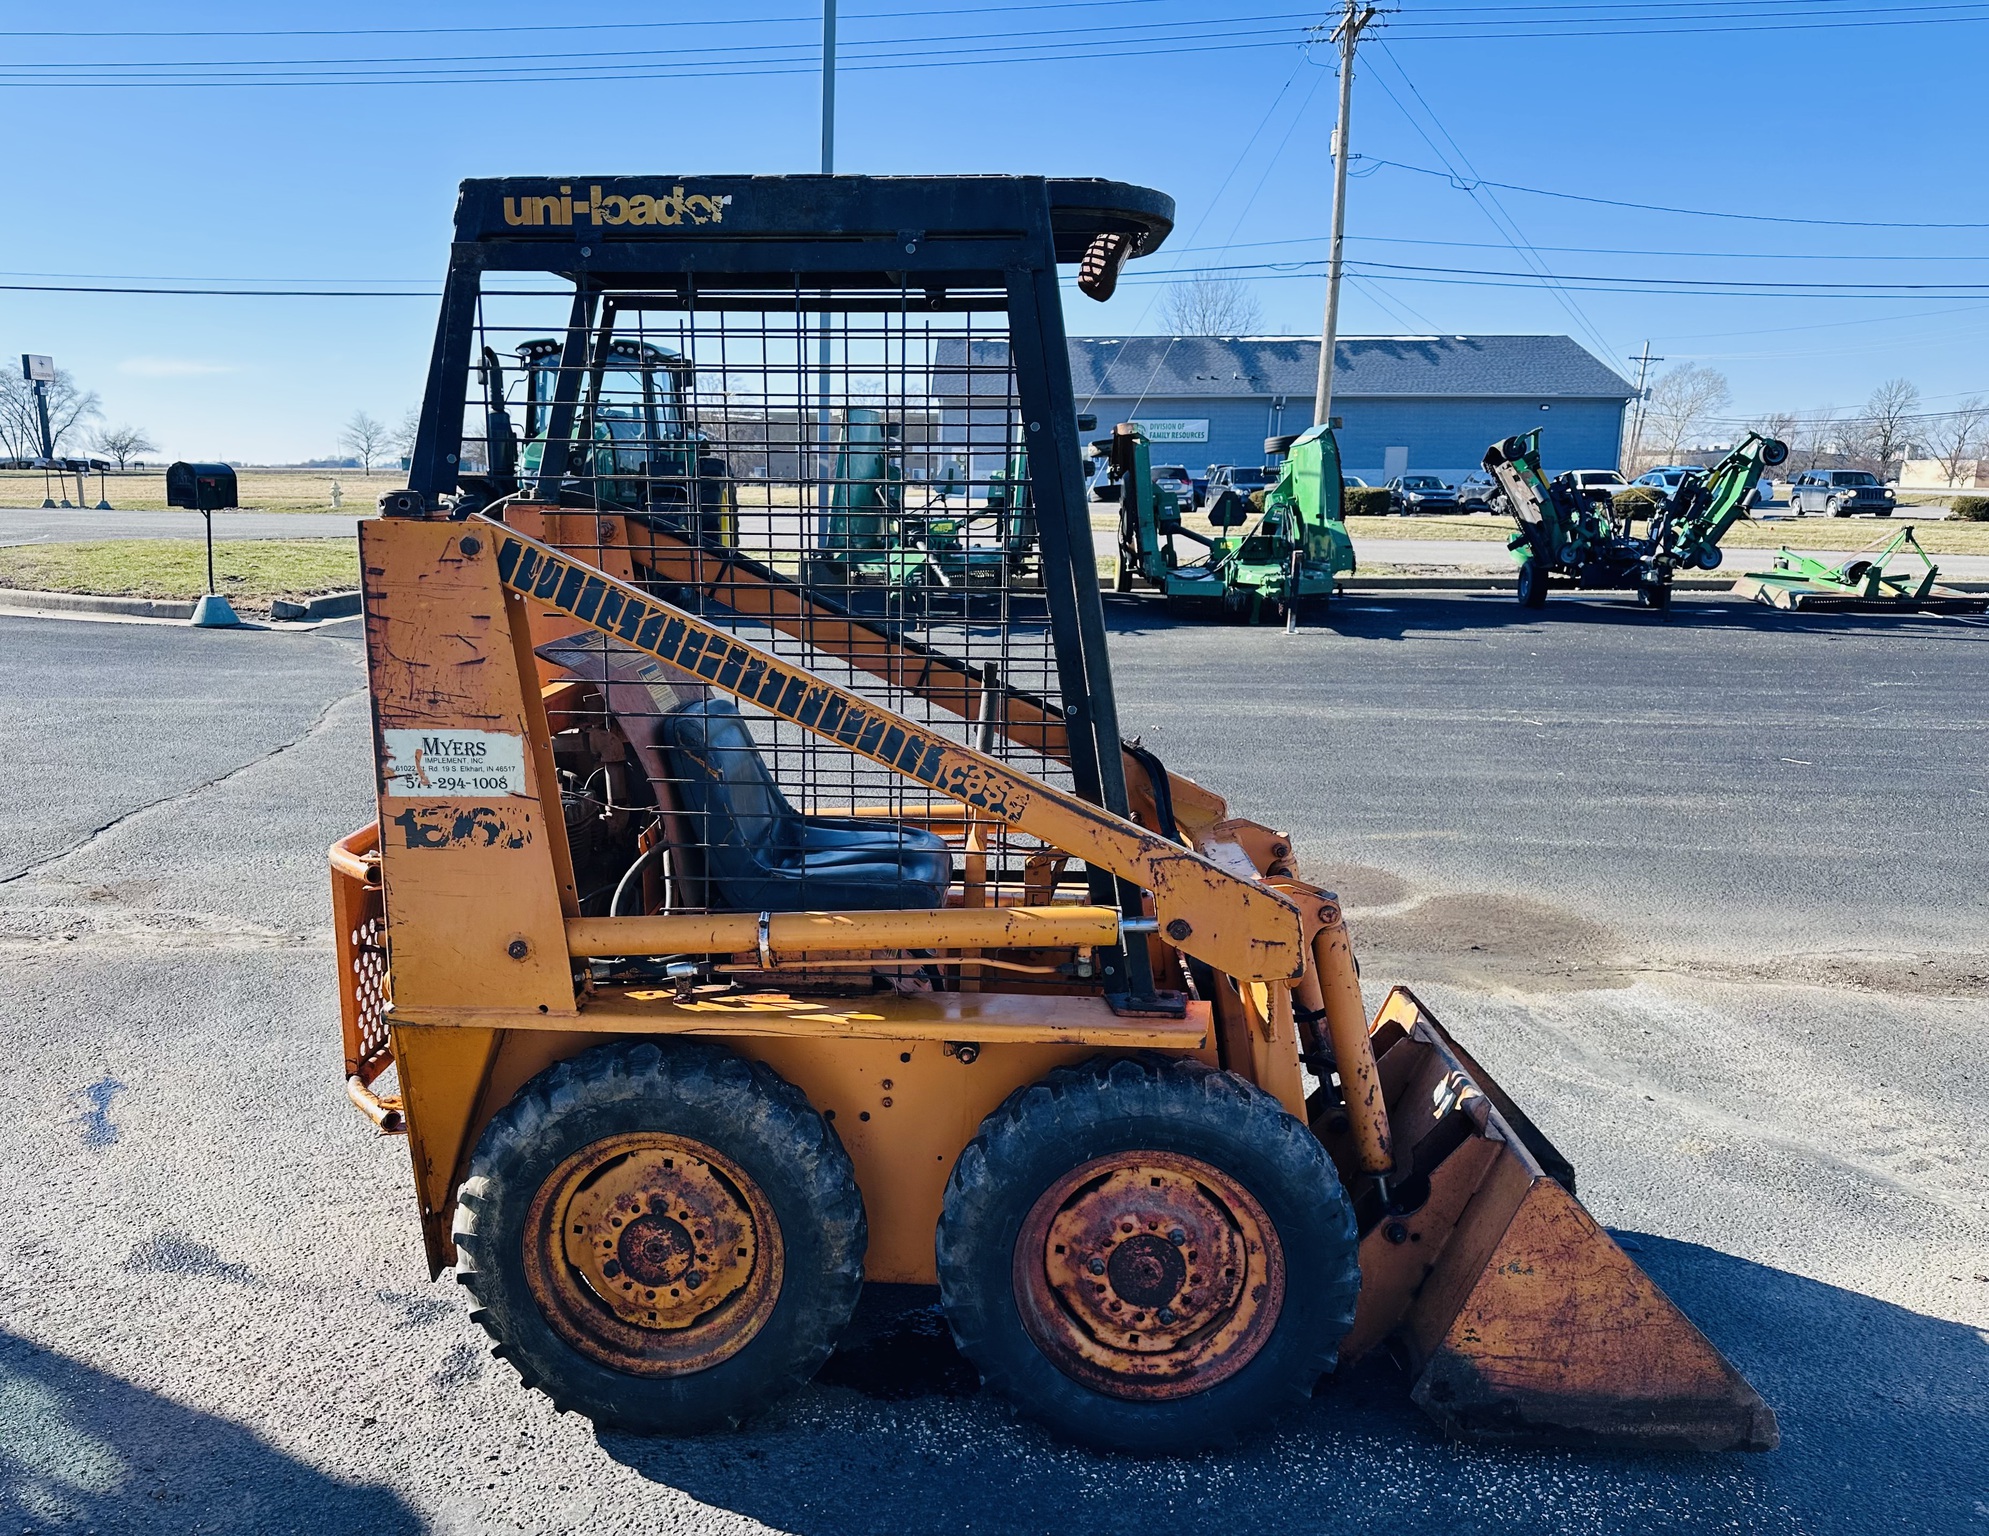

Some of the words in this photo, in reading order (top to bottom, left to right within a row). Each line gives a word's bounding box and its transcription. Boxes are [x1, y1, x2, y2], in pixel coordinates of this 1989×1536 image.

[1149, 422, 1176, 430] DIVISION
[1177, 422, 1185, 430] OF
[1149, 431, 1170, 439] FAMILY
[1171, 431, 1205, 439] RESOURCES
[441, 765, 450, 773] 19
[495, 765, 516, 773] 46517
